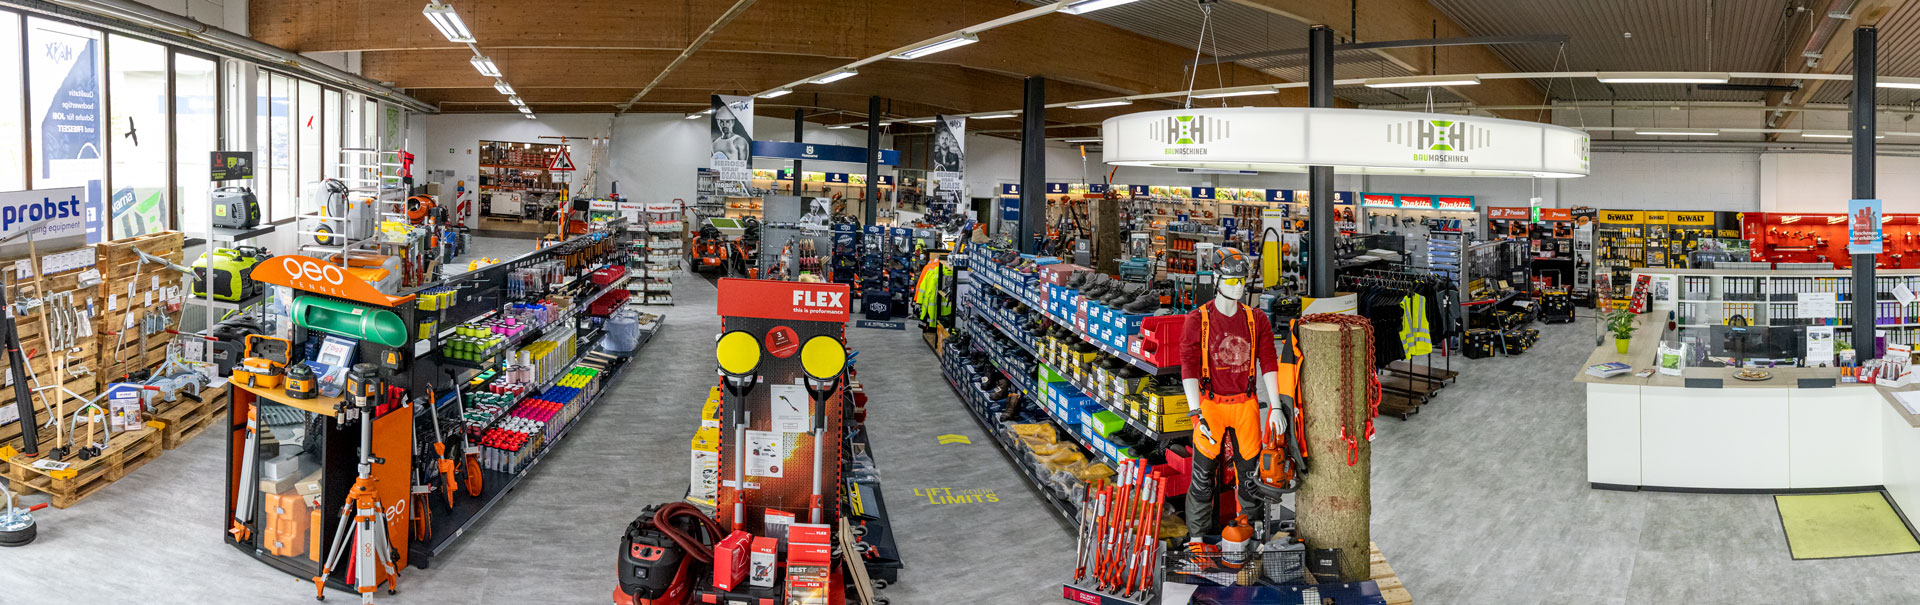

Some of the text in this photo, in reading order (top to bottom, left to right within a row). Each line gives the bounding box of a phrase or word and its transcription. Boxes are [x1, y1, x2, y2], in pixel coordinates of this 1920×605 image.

[1413, 153, 1469, 163] BAUMASCHINEN
[3, 195, 80, 231] probst
[48, 221, 80, 233] equipment
[283, 258, 344, 285] geo
[290, 280, 347, 296] FENNEL
[793, 290, 843, 308] FLEX
